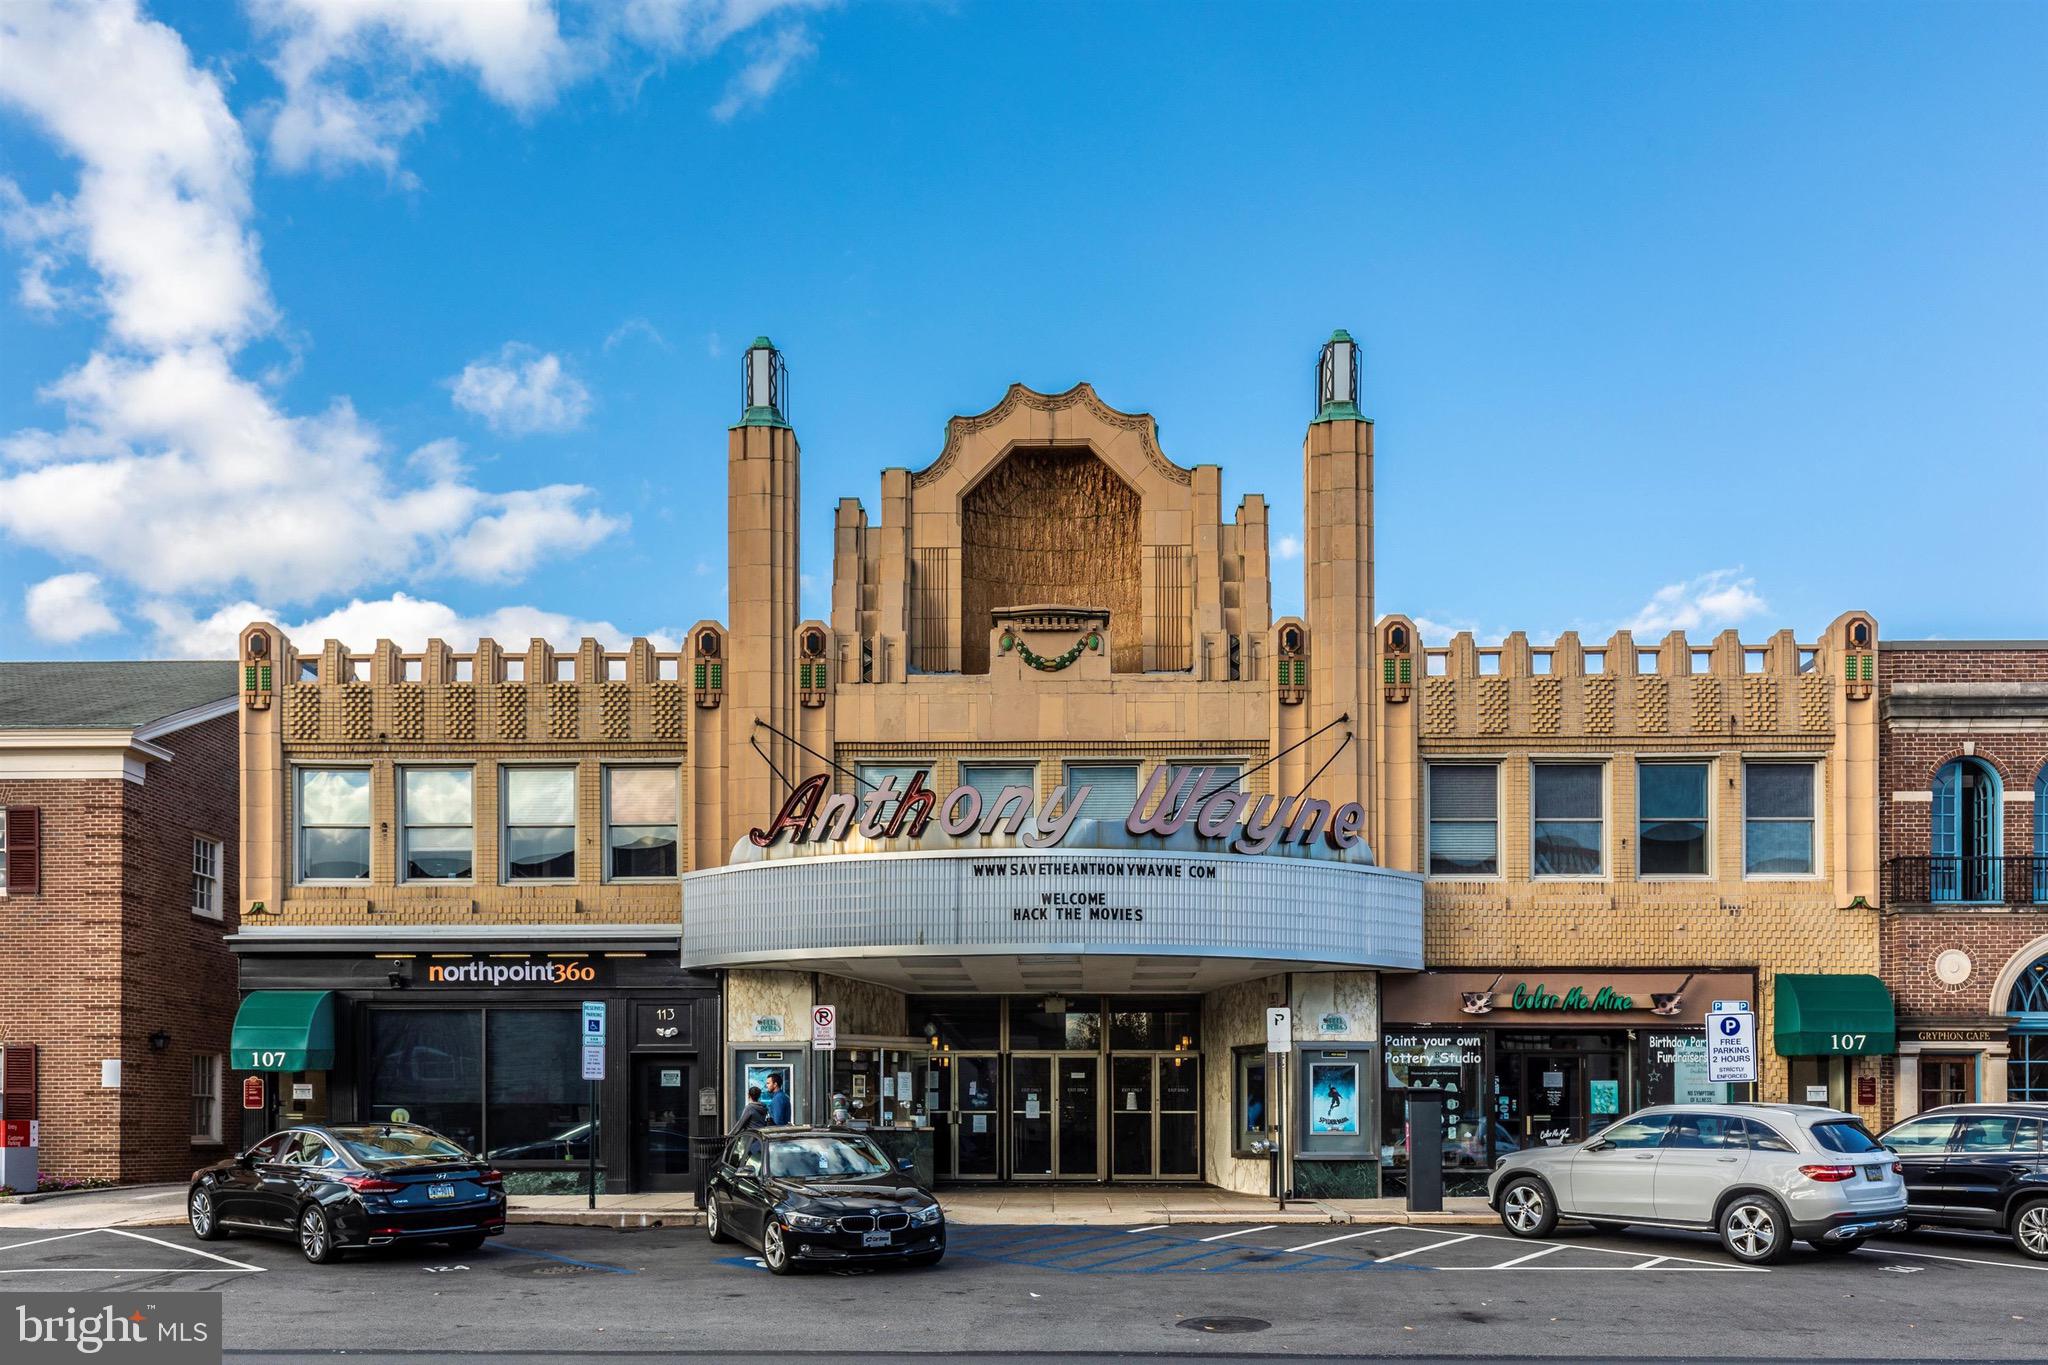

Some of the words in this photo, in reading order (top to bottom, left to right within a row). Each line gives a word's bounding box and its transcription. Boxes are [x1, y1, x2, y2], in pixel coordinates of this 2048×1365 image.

[749, 770, 1092, 848] Anthony
[1126, 764, 1366, 855] Wayne
[1042, 893, 1106, 905] WELCOME
[1014, 908, 1047, 920] HACK
[1056, 908, 1081, 920] THE
[1090, 908, 1143, 921] MOVIES
[429, 961, 595, 986] northpoint360
[1512, 982, 1559, 1009] Color
[1562, 986, 1589, 1010] Me
[1591, 986, 1633, 1010] Mine
[657, 1009, 675, 1020] 113
[1725, 1020, 1736, 1033] P
[1385, 1035, 1417, 1046] Paint
[1423, 1037, 1451, 1049] your
[1457, 1037, 1480, 1046] own
[1649, 1036, 1687, 1050] Birthday
[1831, 1034, 1866, 1050] 107
[1919, 1032, 1963, 1040] GRYPHON
[1966, 1032, 1990, 1040] CAFE
[251, 1052, 285, 1067] 107
[1385, 1052, 1433, 1066] Pottery
[1440, 1052, 1481, 1063] Studio
